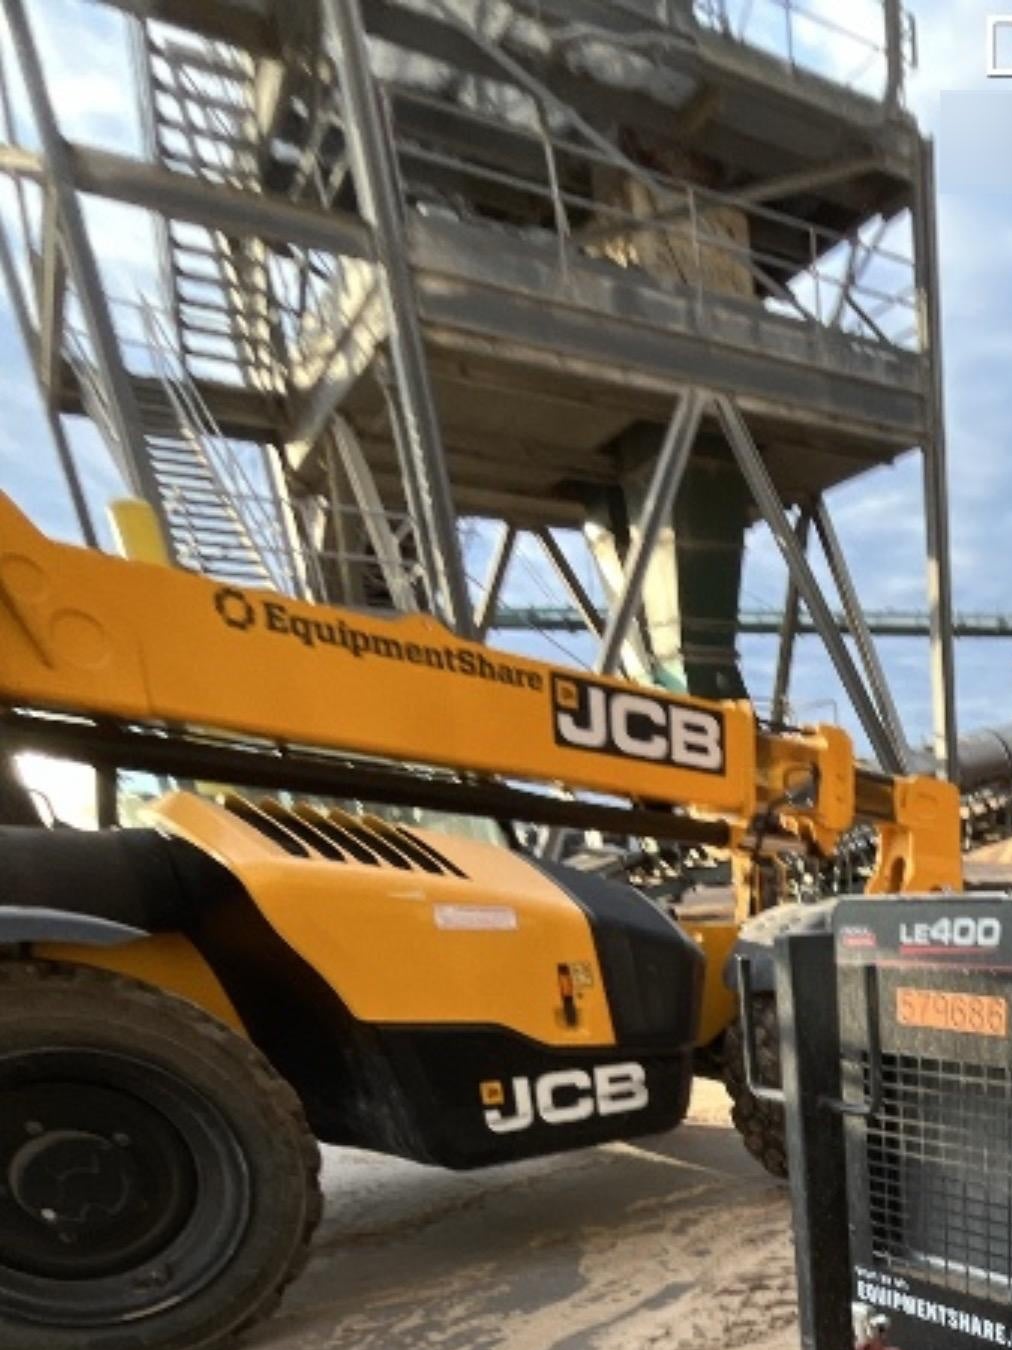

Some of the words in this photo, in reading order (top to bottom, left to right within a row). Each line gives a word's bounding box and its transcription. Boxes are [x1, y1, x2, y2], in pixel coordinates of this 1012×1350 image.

[263, 601, 544, 693] EquipmentShare
[555, 682, 725, 772] JCB
[480, 1061, 650, 1134] JCB
